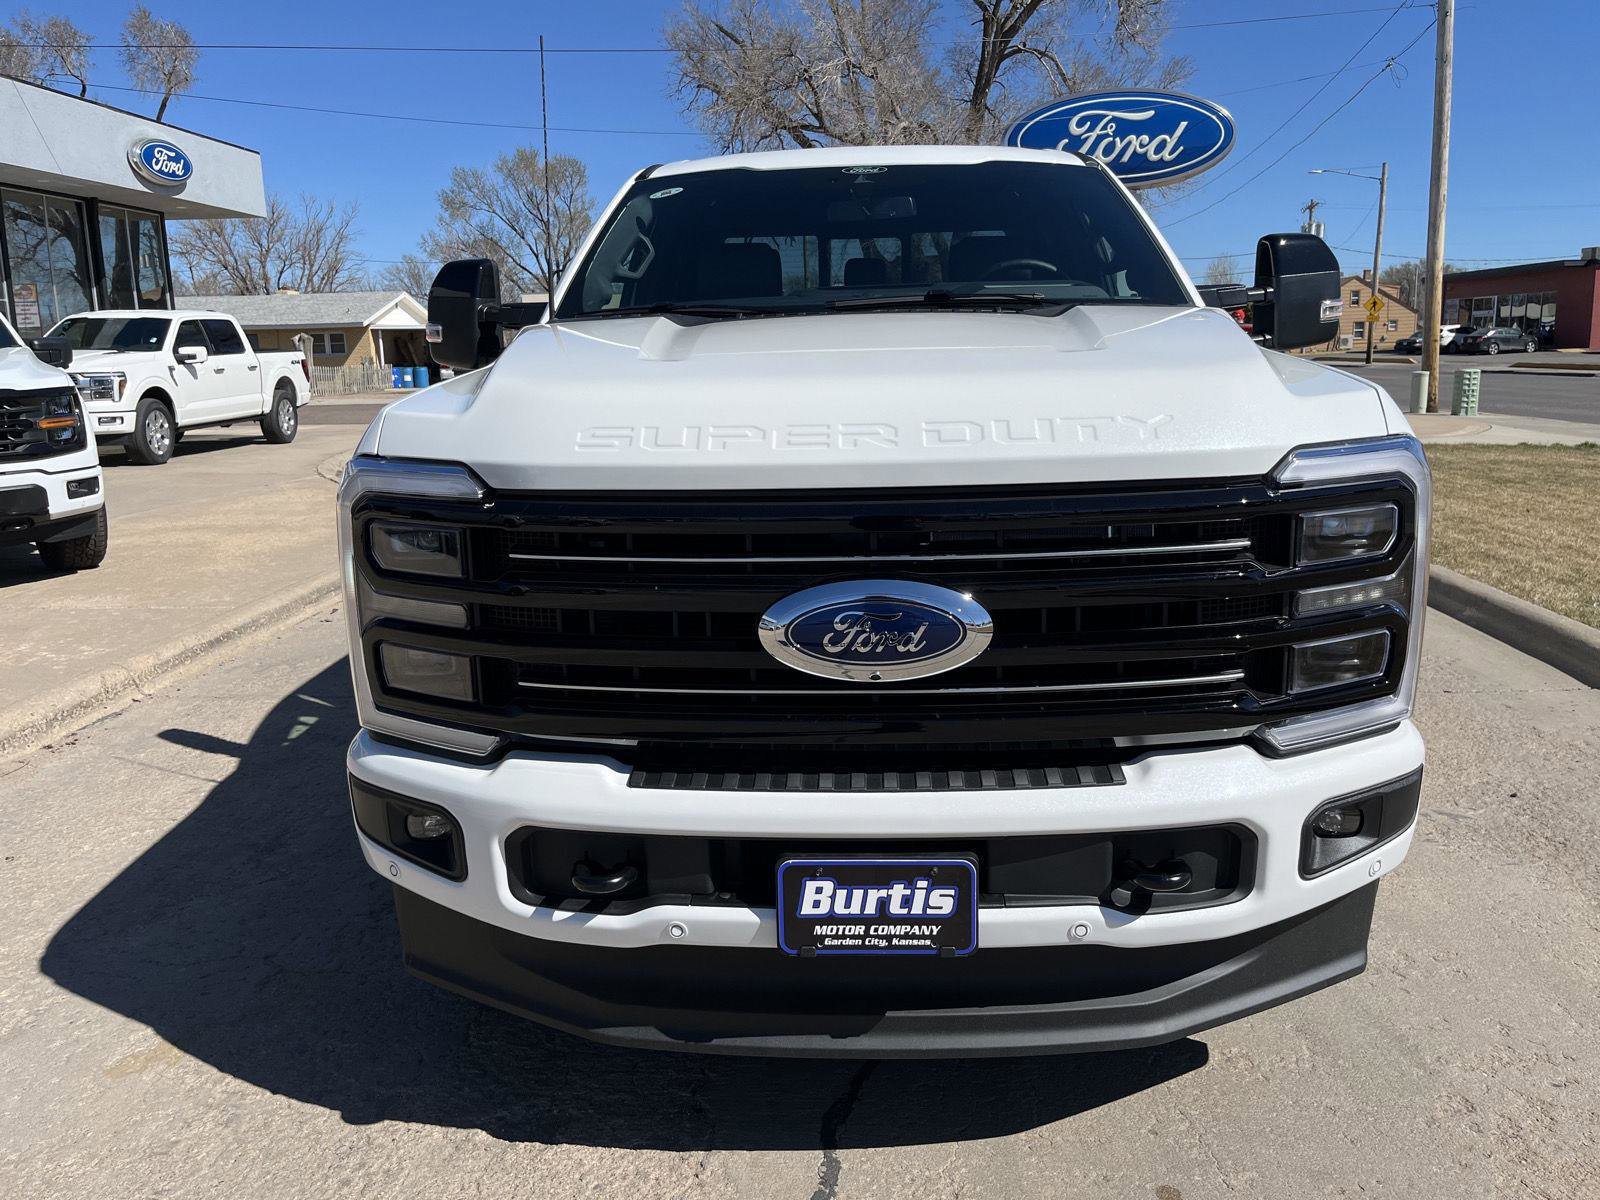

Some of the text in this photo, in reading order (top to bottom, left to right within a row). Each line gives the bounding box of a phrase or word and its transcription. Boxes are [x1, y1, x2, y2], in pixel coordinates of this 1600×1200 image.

[1056, 110, 1188, 163] Ford
[152, 147, 185, 175] Ford
[574, 414, 1174, 451] SUPER DUTY
[823, 611, 928, 652] Ford
[800, 880, 955, 915] Burtis
[813, 925, 941, 935] MOTOR COMPANY
[824, 937, 862, 946] Garden
[865, 937, 889, 947] City,
